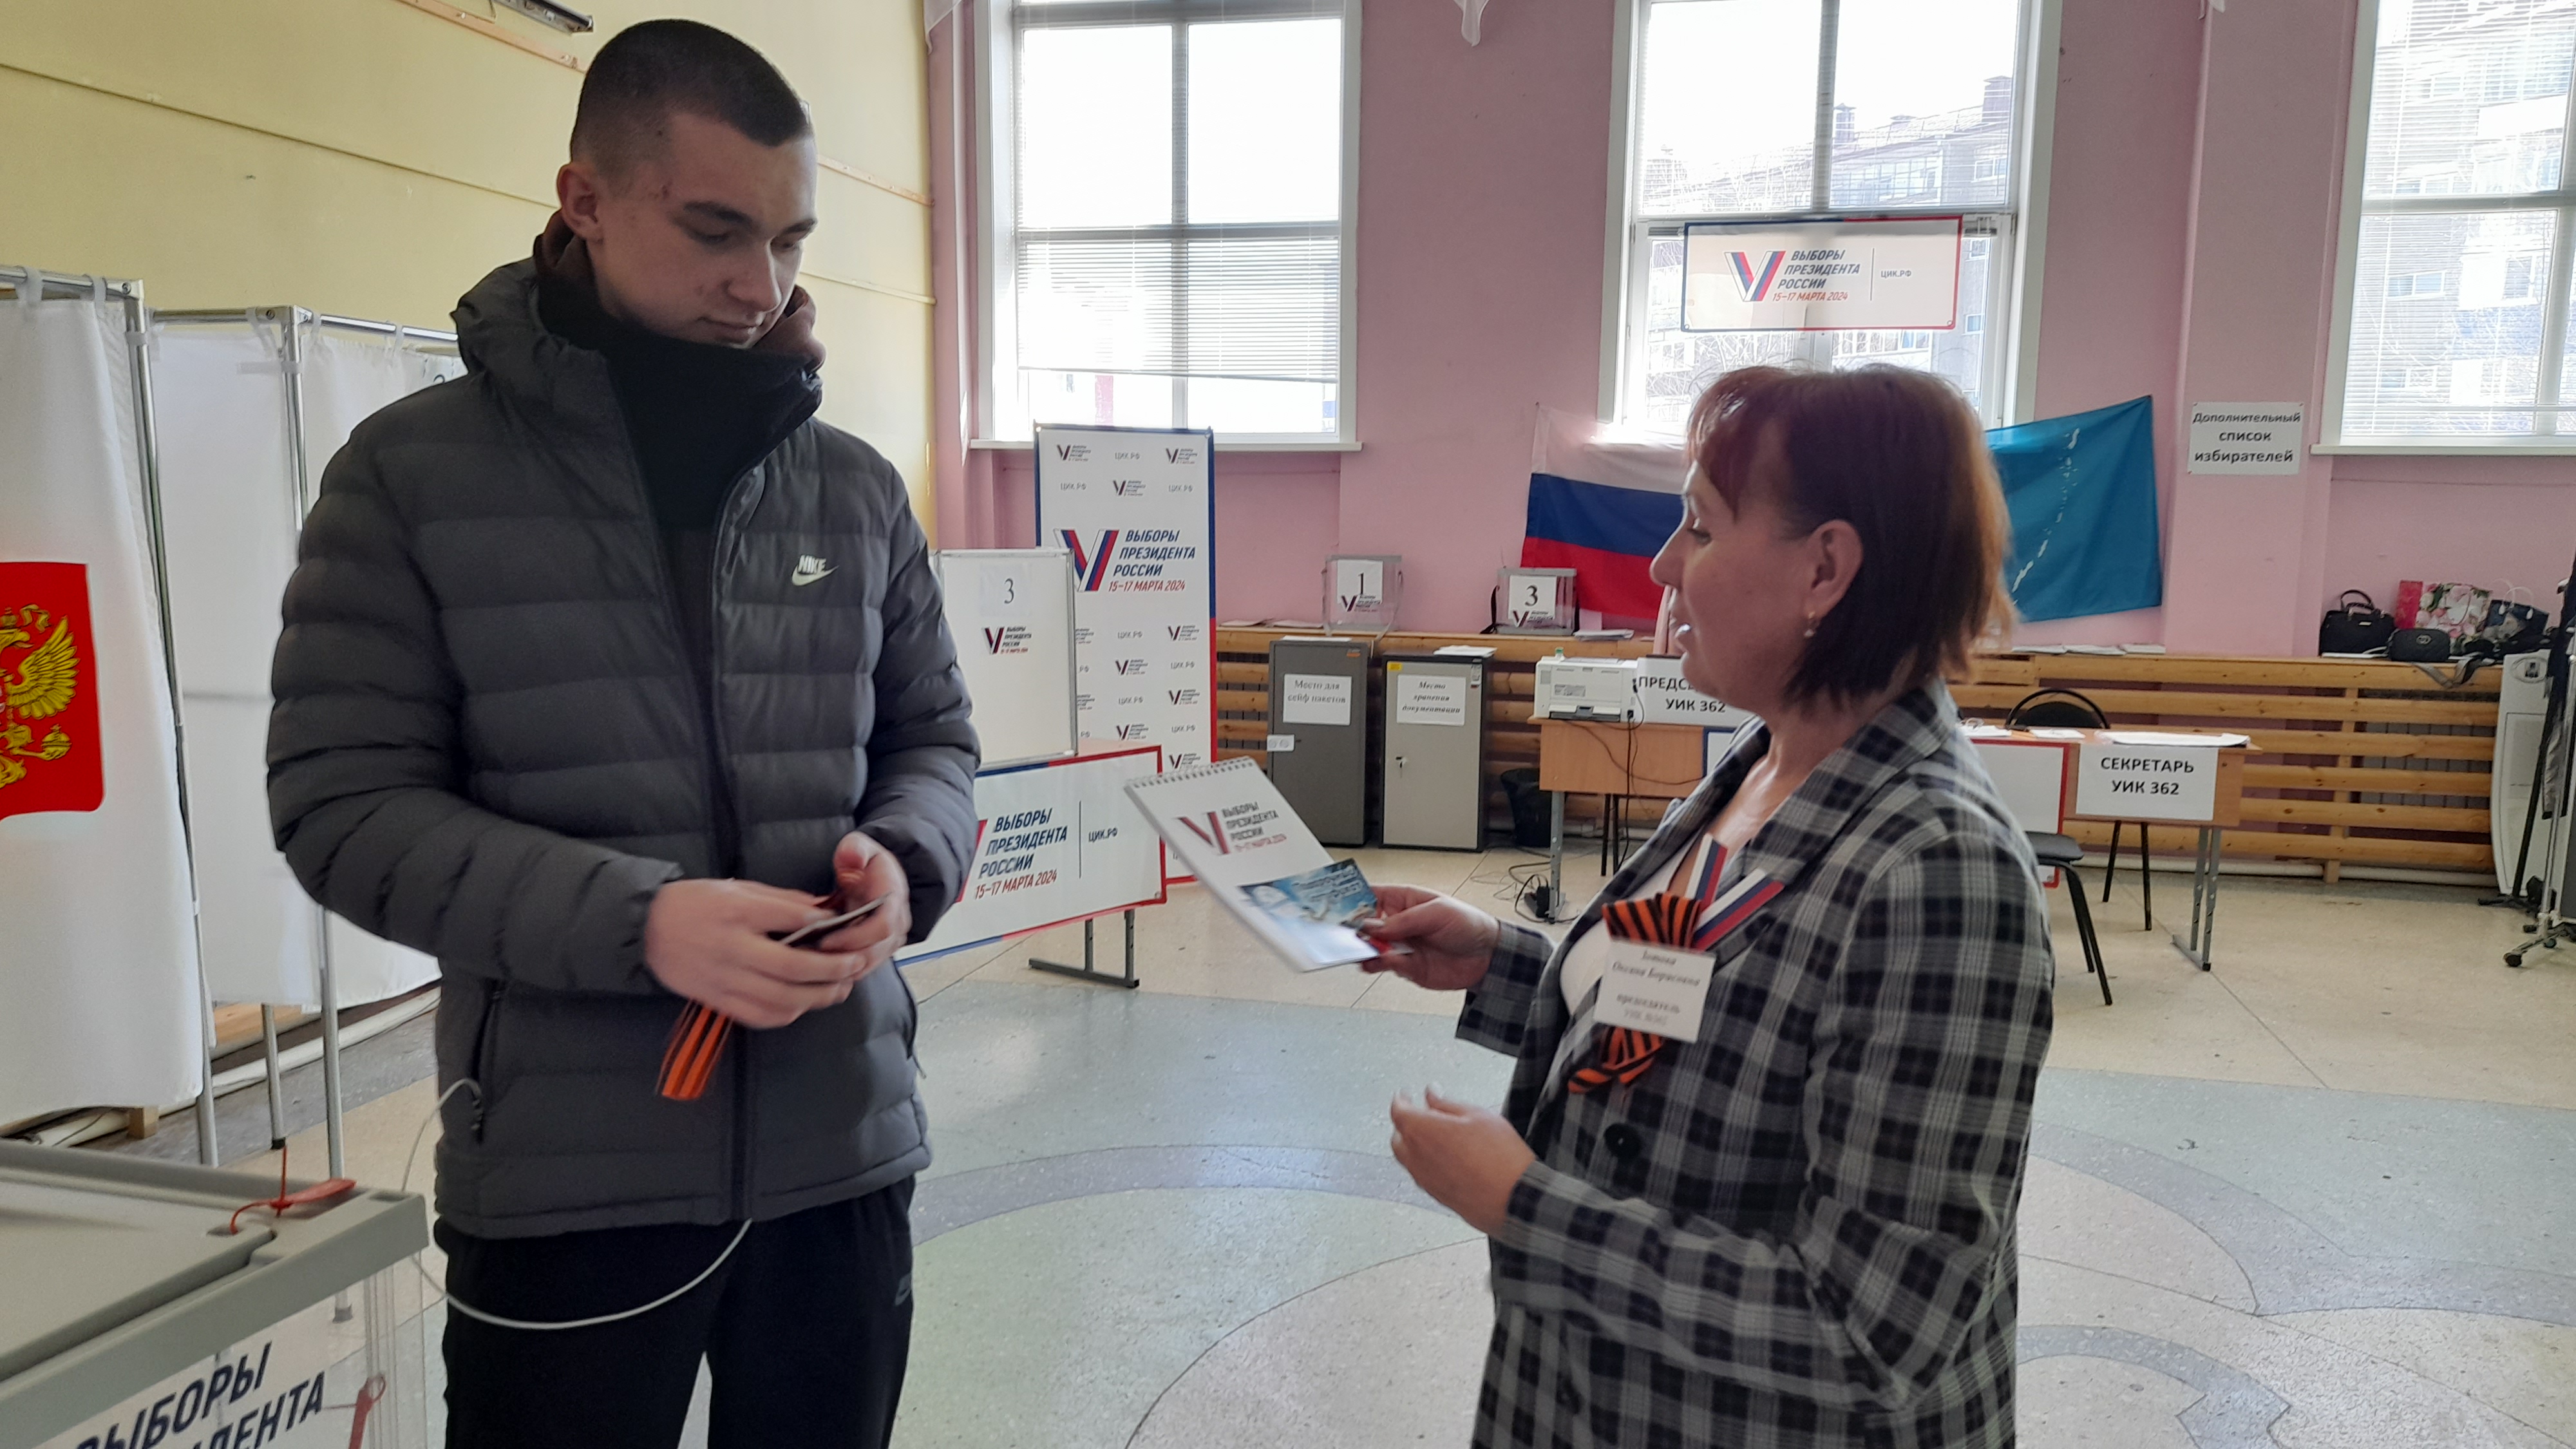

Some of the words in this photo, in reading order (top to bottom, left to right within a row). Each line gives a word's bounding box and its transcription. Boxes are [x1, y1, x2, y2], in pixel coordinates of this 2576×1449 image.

[1791, 250, 1846, 261] ВЫБОРЫ
[1784, 263, 1861, 276] ПРЕЗИДЕНТА
[1880, 270, 1911, 279] ЦИК.РФ
[1777, 279, 1826, 290] РОССИИ
[1797, 292, 1826, 301] МАРТА
[1827, 292, 1848, 301] 2024
[2192, 412, 2301, 424] Дополнительный
[2219, 431, 2273, 441] список
[2194, 449, 2293, 464] избирателей
[1125, 529, 1180, 542] ВЫБОРЫ
[1119, 547, 1195, 561] ПРЕЗИДЕНТА
[798, 554, 826, 573] NIKE
[1113, 564, 1163, 577] РОССИИ
[1134, 580, 1163, 592] МАРТА
[1164, 580, 1186, 592] 2024
[1358, 572, 1364, 594] 1
[1004, 578, 1014, 604] 3
[1525, 585, 1538, 606] 3
[1294, 679, 1322, 690] Место
[1665, 698, 1695, 711] УИК
[1700, 700, 1726, 713] 362
[2101, 757, 2194, 773] СЕКРЕТАРЬ
[2111, 780, 2145, 793] УИК
[2150, 782, 2179, 795] 362
[992, 808, 1053, 833] ВЫБОРЫ
[985, 826, 1068, 857] ПРЕЗИДЕНТА
[1088, 828, 1118, 843] ЦИК.РФ
[978, 855, 1034, 880] РОССИИ
[1003, 874, 1033, 895] МАРТА
[1034, 870, 1057, 887] 2024
